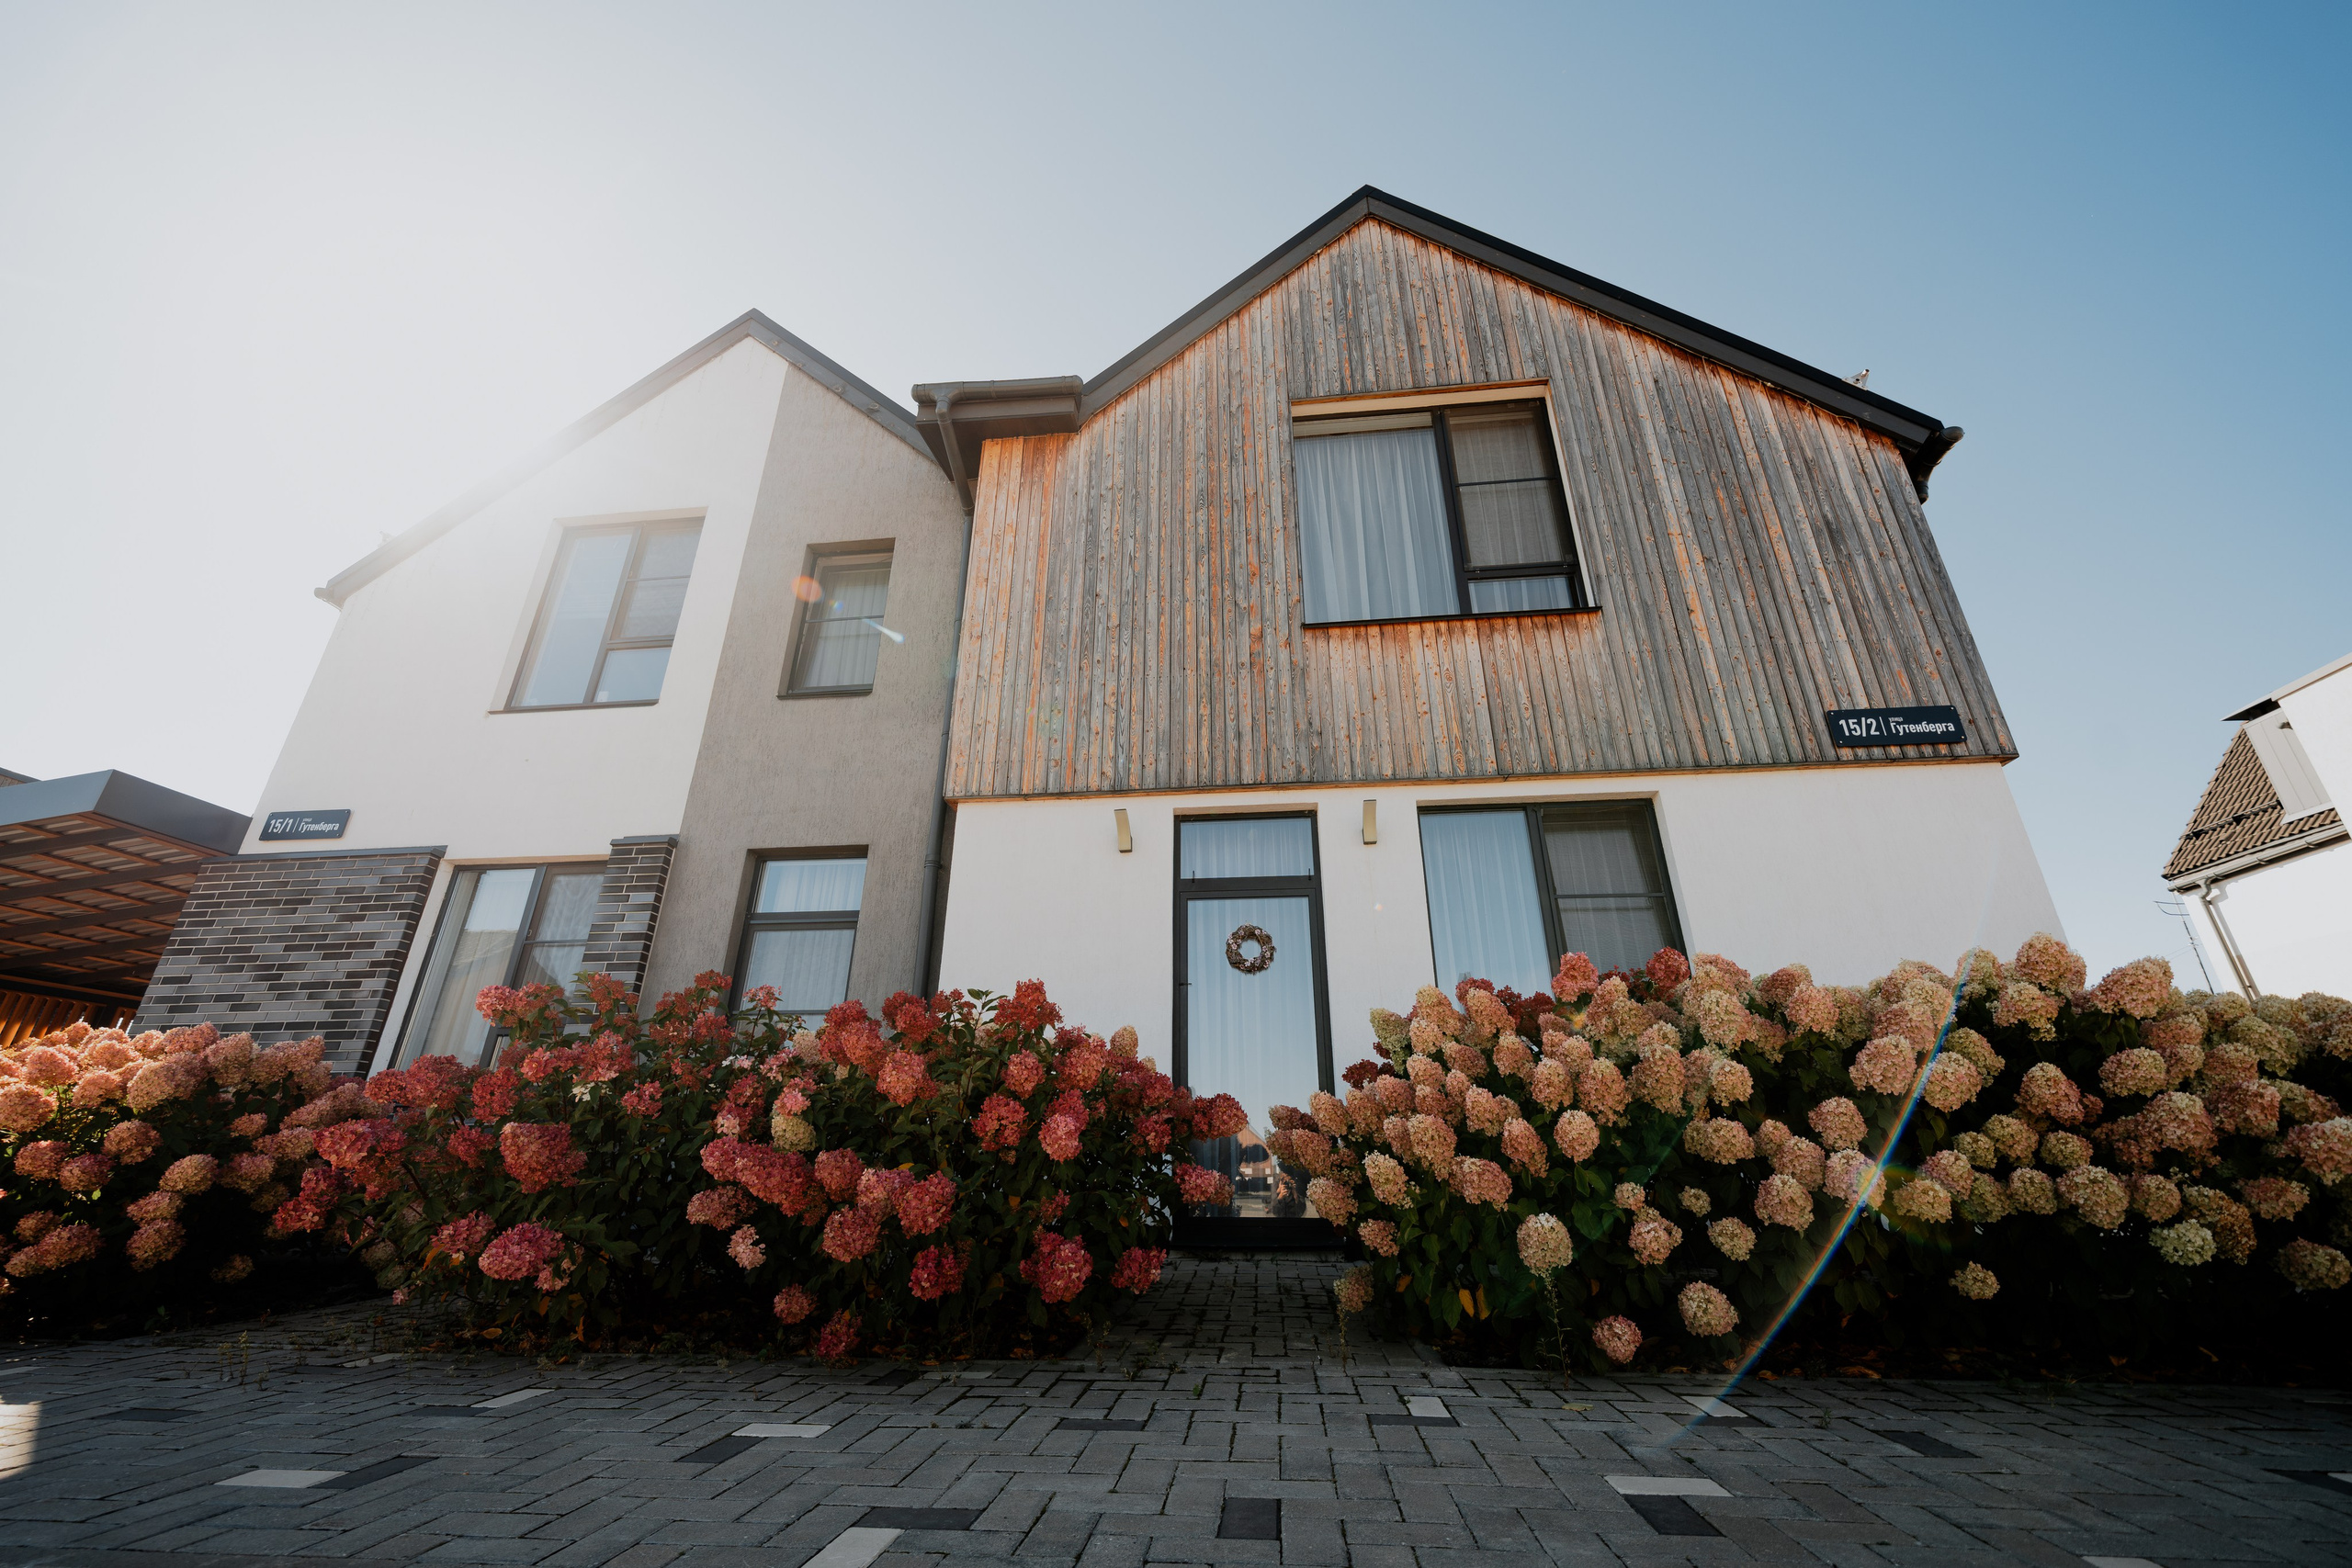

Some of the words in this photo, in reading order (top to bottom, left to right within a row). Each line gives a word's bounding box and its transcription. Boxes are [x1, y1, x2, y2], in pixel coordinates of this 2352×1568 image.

[1838, 716, 1880, 737] 15/2
[1890, 721, 1955, 736] Гутенберга
[268, 818, 294, 833] 15/1
[299, 821, 340, 833] Гутенберга
